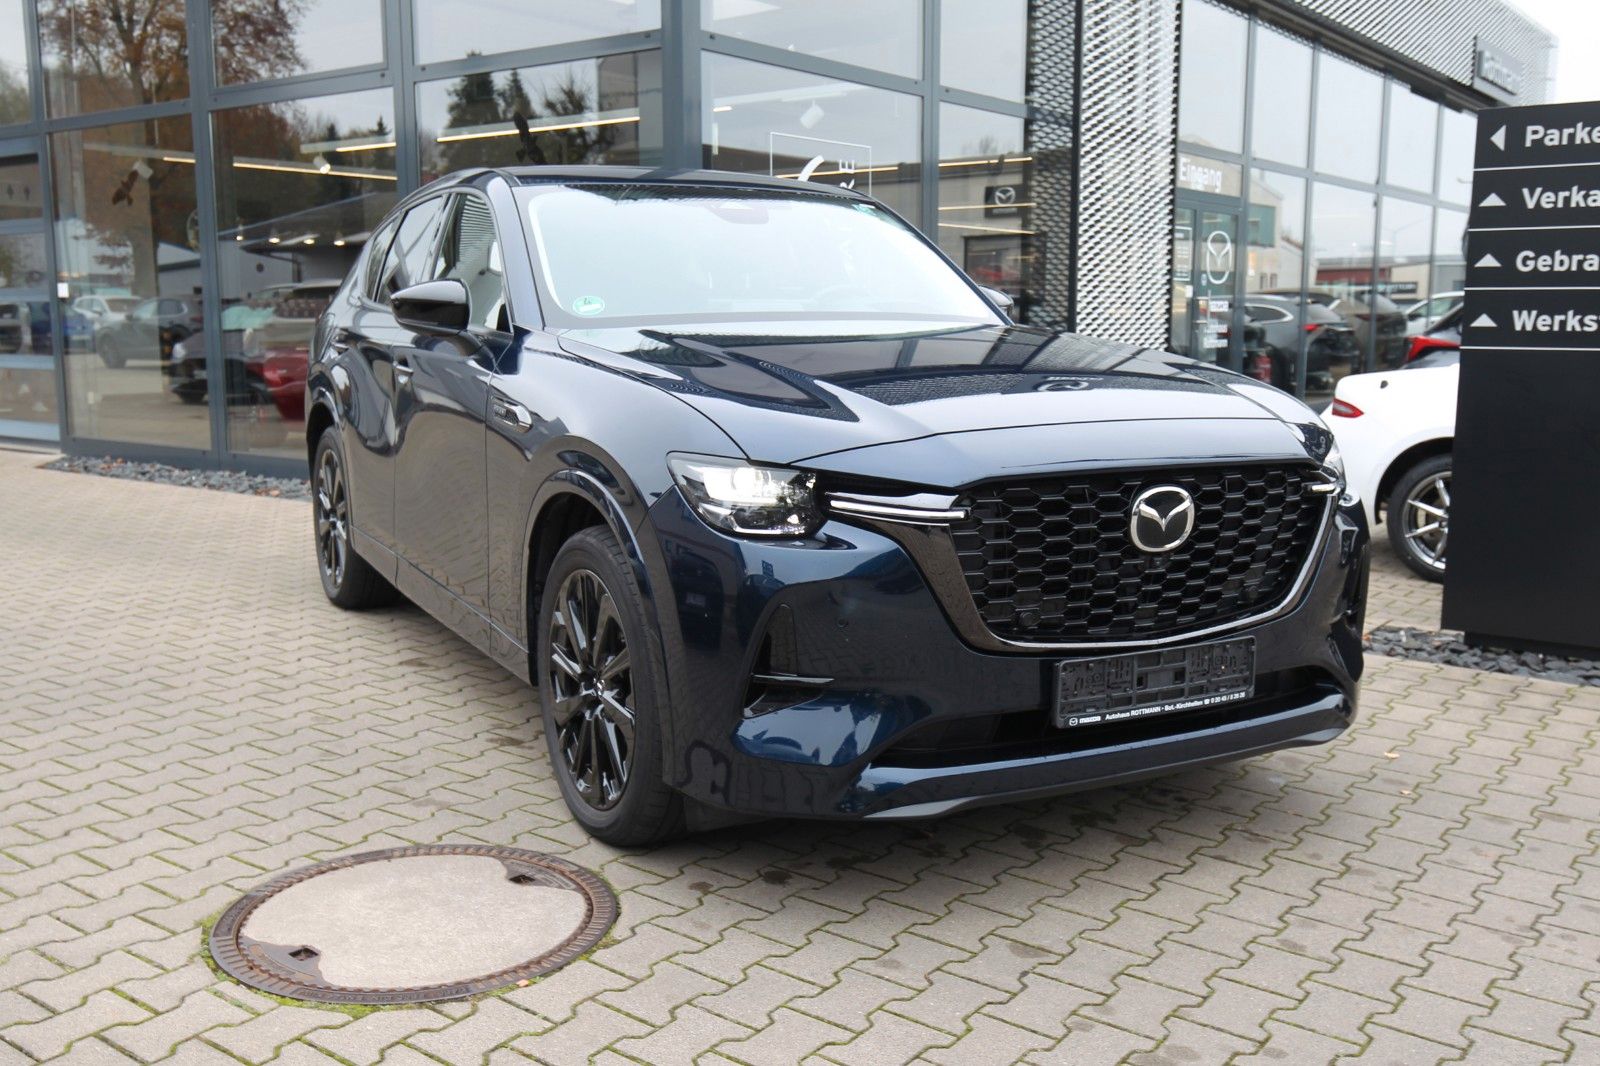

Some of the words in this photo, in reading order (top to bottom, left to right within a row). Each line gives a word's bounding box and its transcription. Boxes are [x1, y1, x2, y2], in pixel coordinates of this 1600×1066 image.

[1524, 121, 1600, 147] Parke
[1179, 157, 1222, 193] Eingang
[1522, 185, 1600, 209] Verka
[1515, 249, 1600, 272] Gebra
[1512, 309, 1600, 331] Werks
[1105, 712, 1130, 720] Autohaus
[1131, 706, 1161, 716] ROTTMANN
